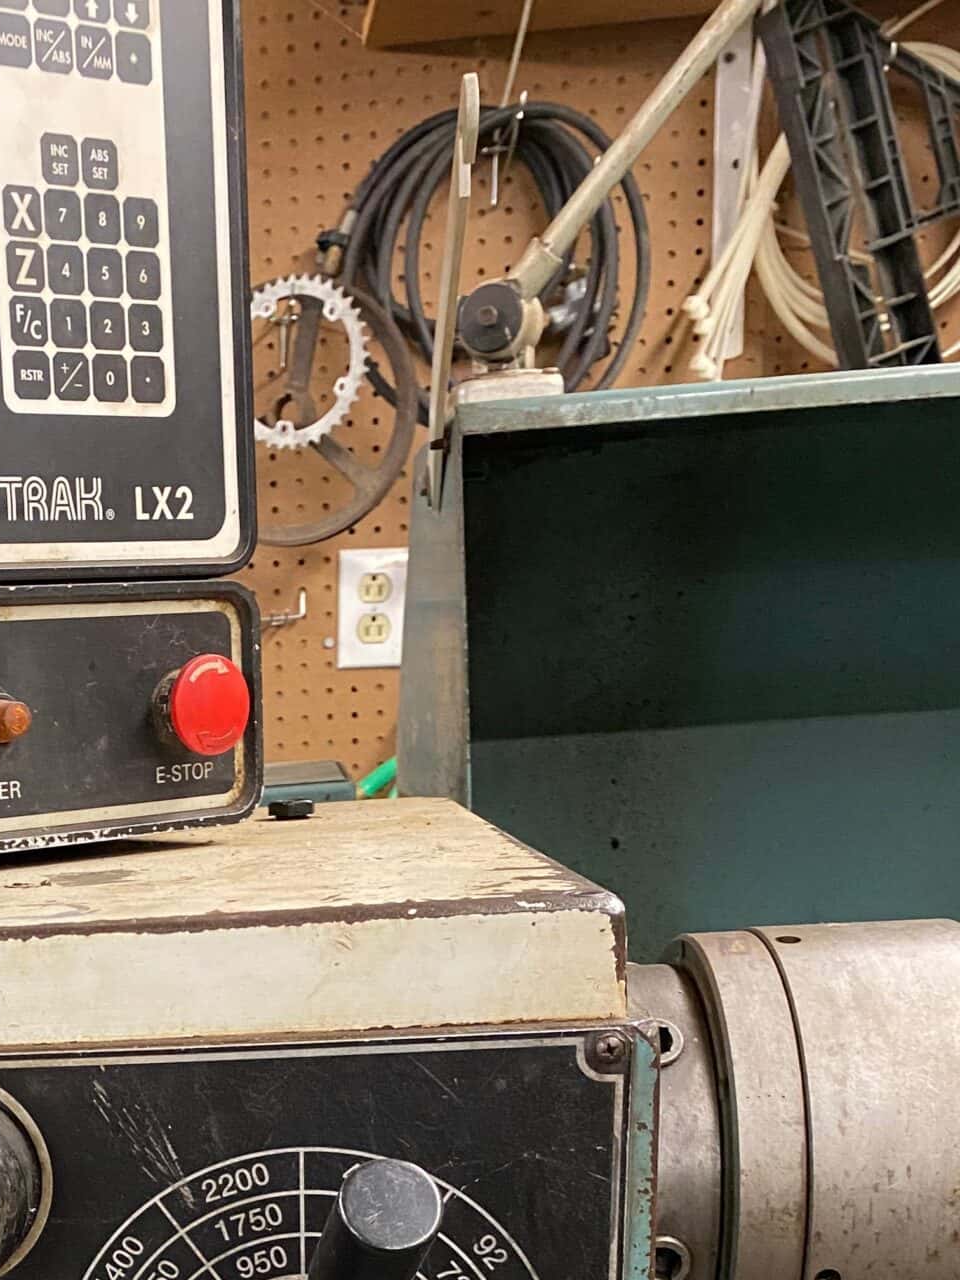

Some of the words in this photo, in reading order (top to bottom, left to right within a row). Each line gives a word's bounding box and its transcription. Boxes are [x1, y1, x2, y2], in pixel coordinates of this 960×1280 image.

[50, 144, 69, 158] INC
[90, 148, 109, 163] ABS
[52, 163, 69, 177] SET
[93, 166, 109, 181] SET
[10, 191, 35, 232] X
[59, 208, 67, 223] 7
[98, 211, 107, 227] 8
[137, 215, 145, 230] 9
[15, 248, 37, 286] Z
[61, 263, 70, 279] 4
[101, 265, 109, 281] 5
[139, 268, 148, 284] 6
[104, 319, 112, 335] 2
[142, 320, 150, 336] 3
[20, 369, 44, 383] RSTR
[106, 371, 115, 386] 0
[134, 485, 195, 522] LX2
[155, 762, 215, 786] E-STOP
[201, 1162, 271, 1203] 2200
[214, 1203, 285, 1244] 1750
[472, 1234, 508, 1270] 92
[235, 1245, 289, 1280] 950
